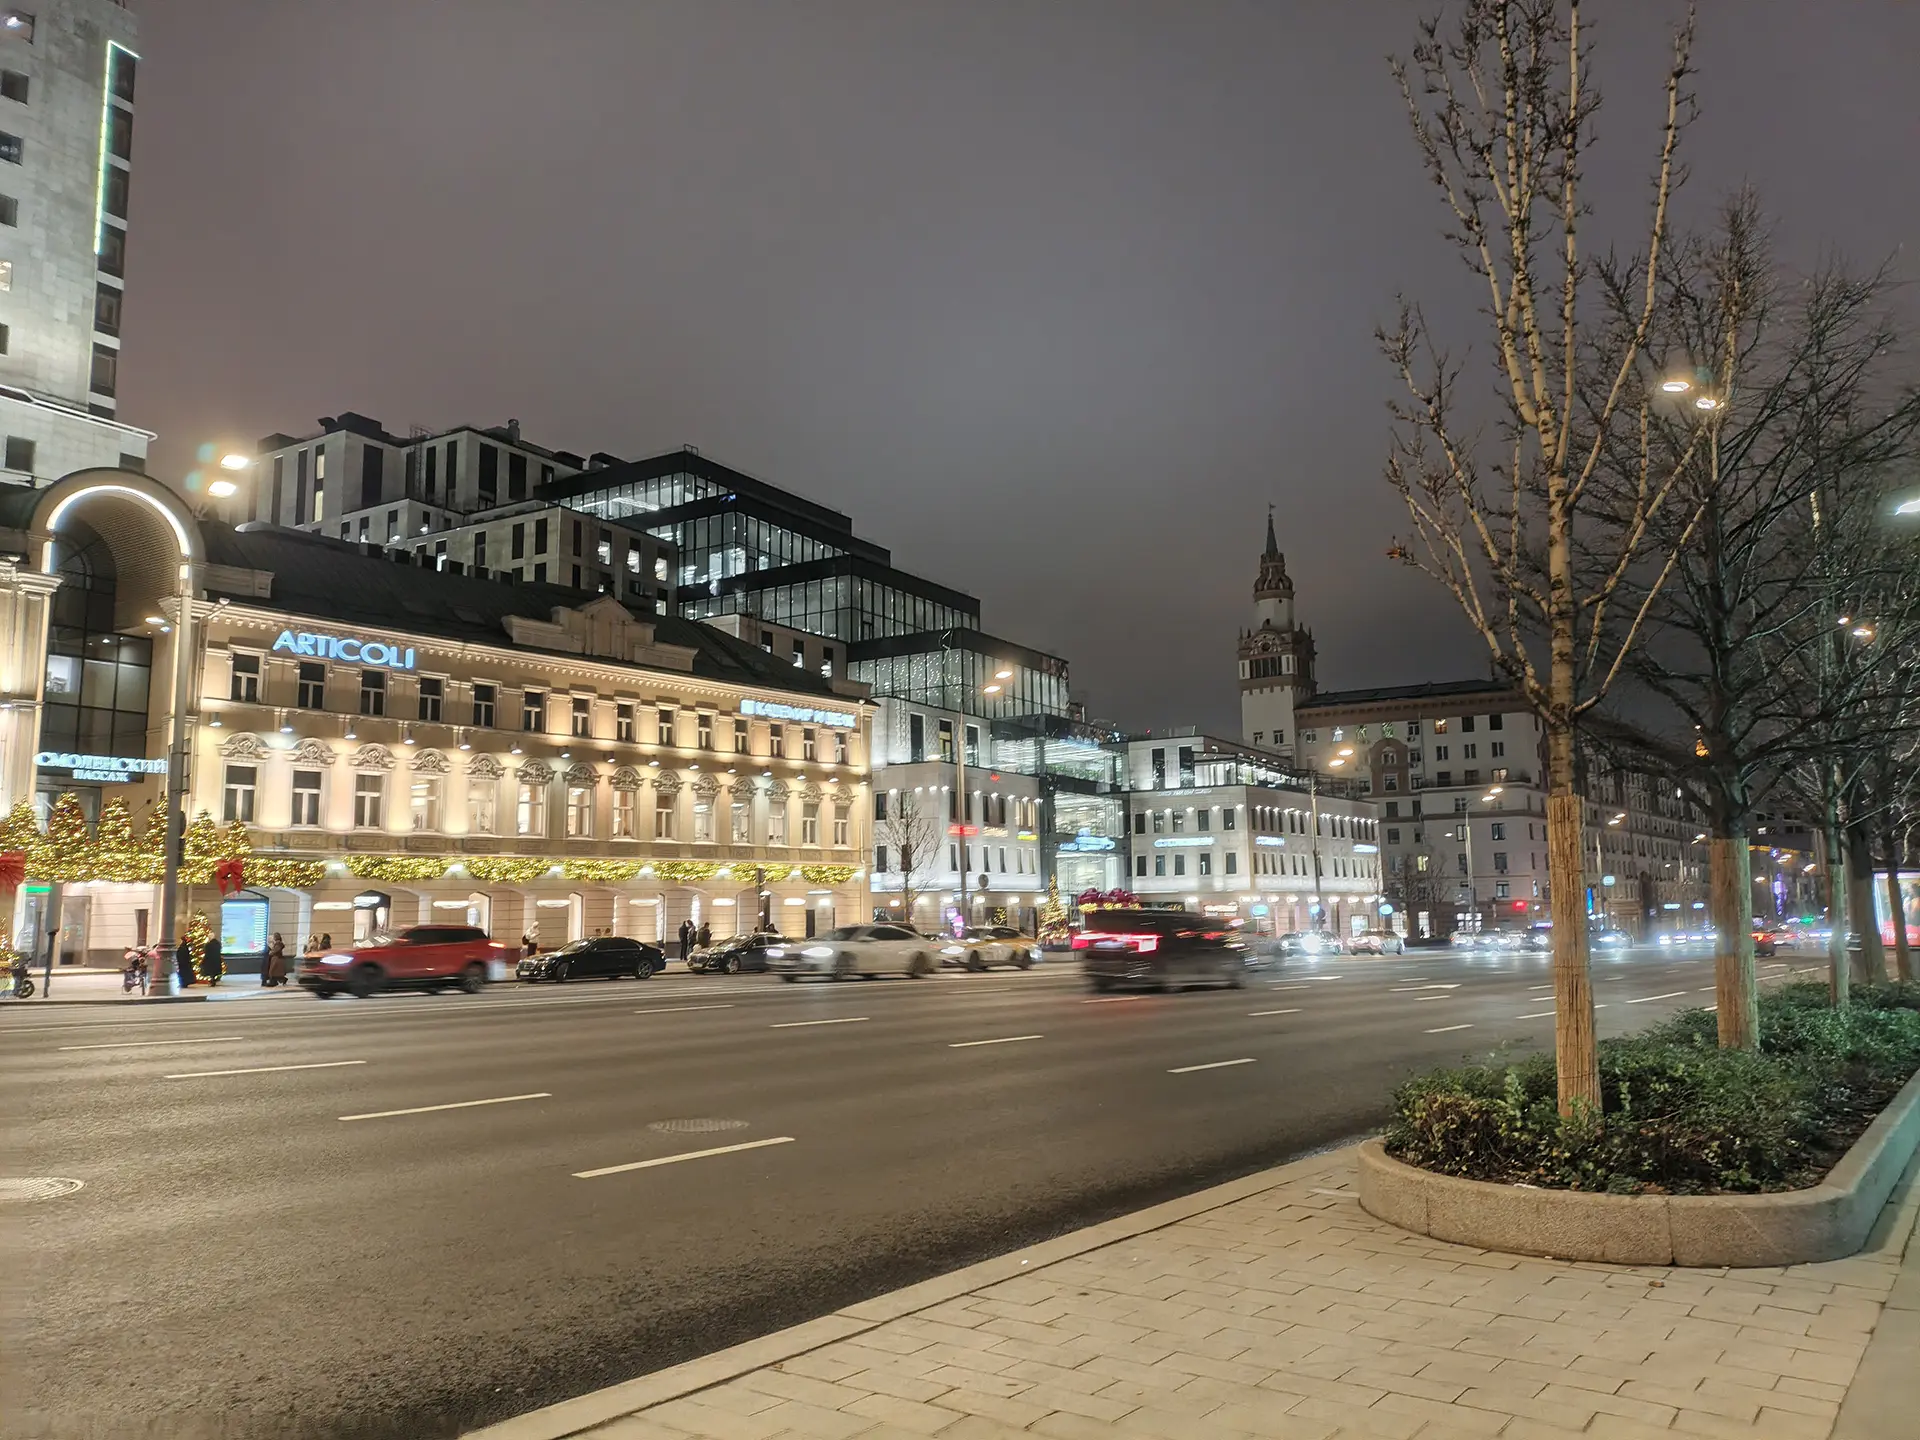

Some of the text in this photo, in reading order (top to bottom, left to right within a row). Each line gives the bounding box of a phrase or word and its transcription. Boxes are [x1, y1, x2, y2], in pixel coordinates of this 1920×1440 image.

[272, 629, 415, 670] ARTICOLI
[33, 751, 168, 774] СМОЛЕНСКИЙ
[72, 768, 129, 782] ПАССАЖ
